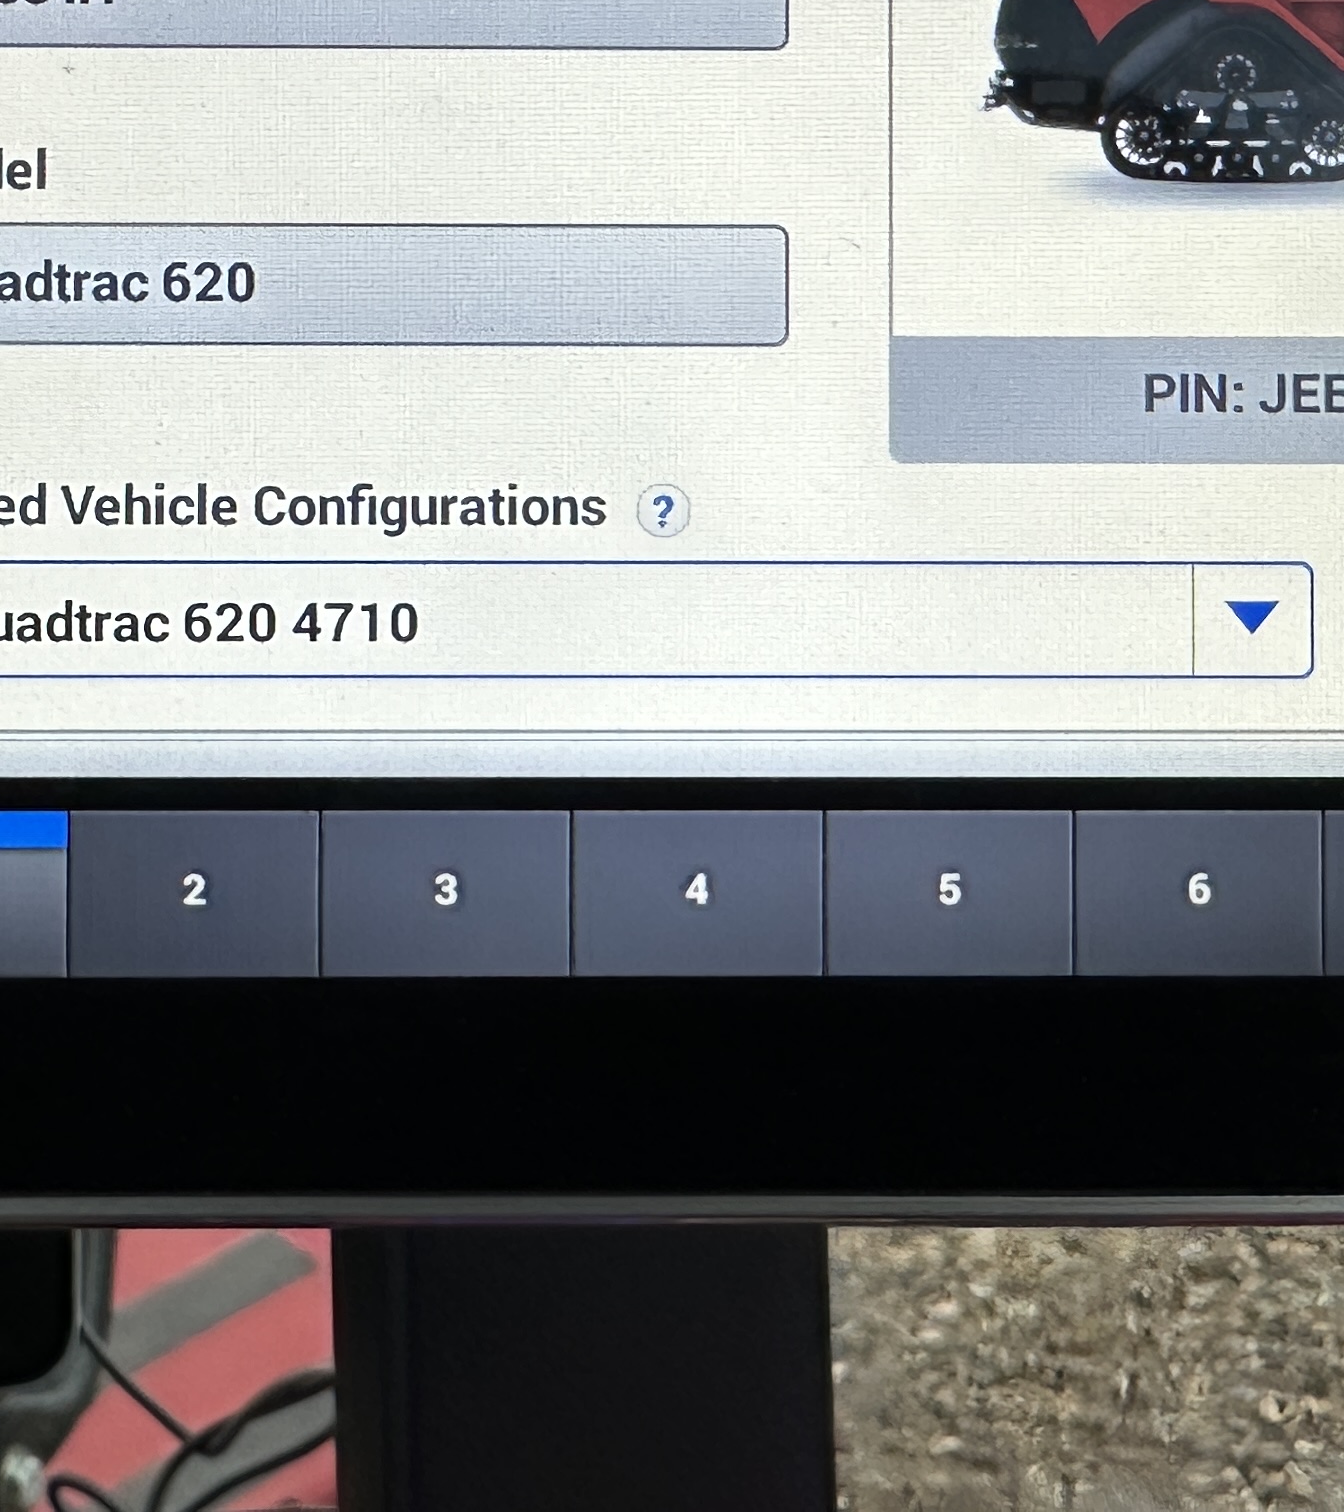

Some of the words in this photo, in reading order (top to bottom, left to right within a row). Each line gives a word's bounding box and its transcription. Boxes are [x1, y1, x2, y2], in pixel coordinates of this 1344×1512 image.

[164, 262, 254, 302] 620
[1145, 373, 1243, 412] PIN:
[61, 483, 237, 526] Vehicle
[255, 483, 606, 537] Configurations
[185, 603, 275, 643] 620
[293, 603, 417, 643] 4710
[183, 874, 206, 905] 2
[435, 873, 457, 905] 3
[686, 873, 708, 904] 4
[940, 873, 961, 905] 5
[1186, 873, 1212, 907] 6
